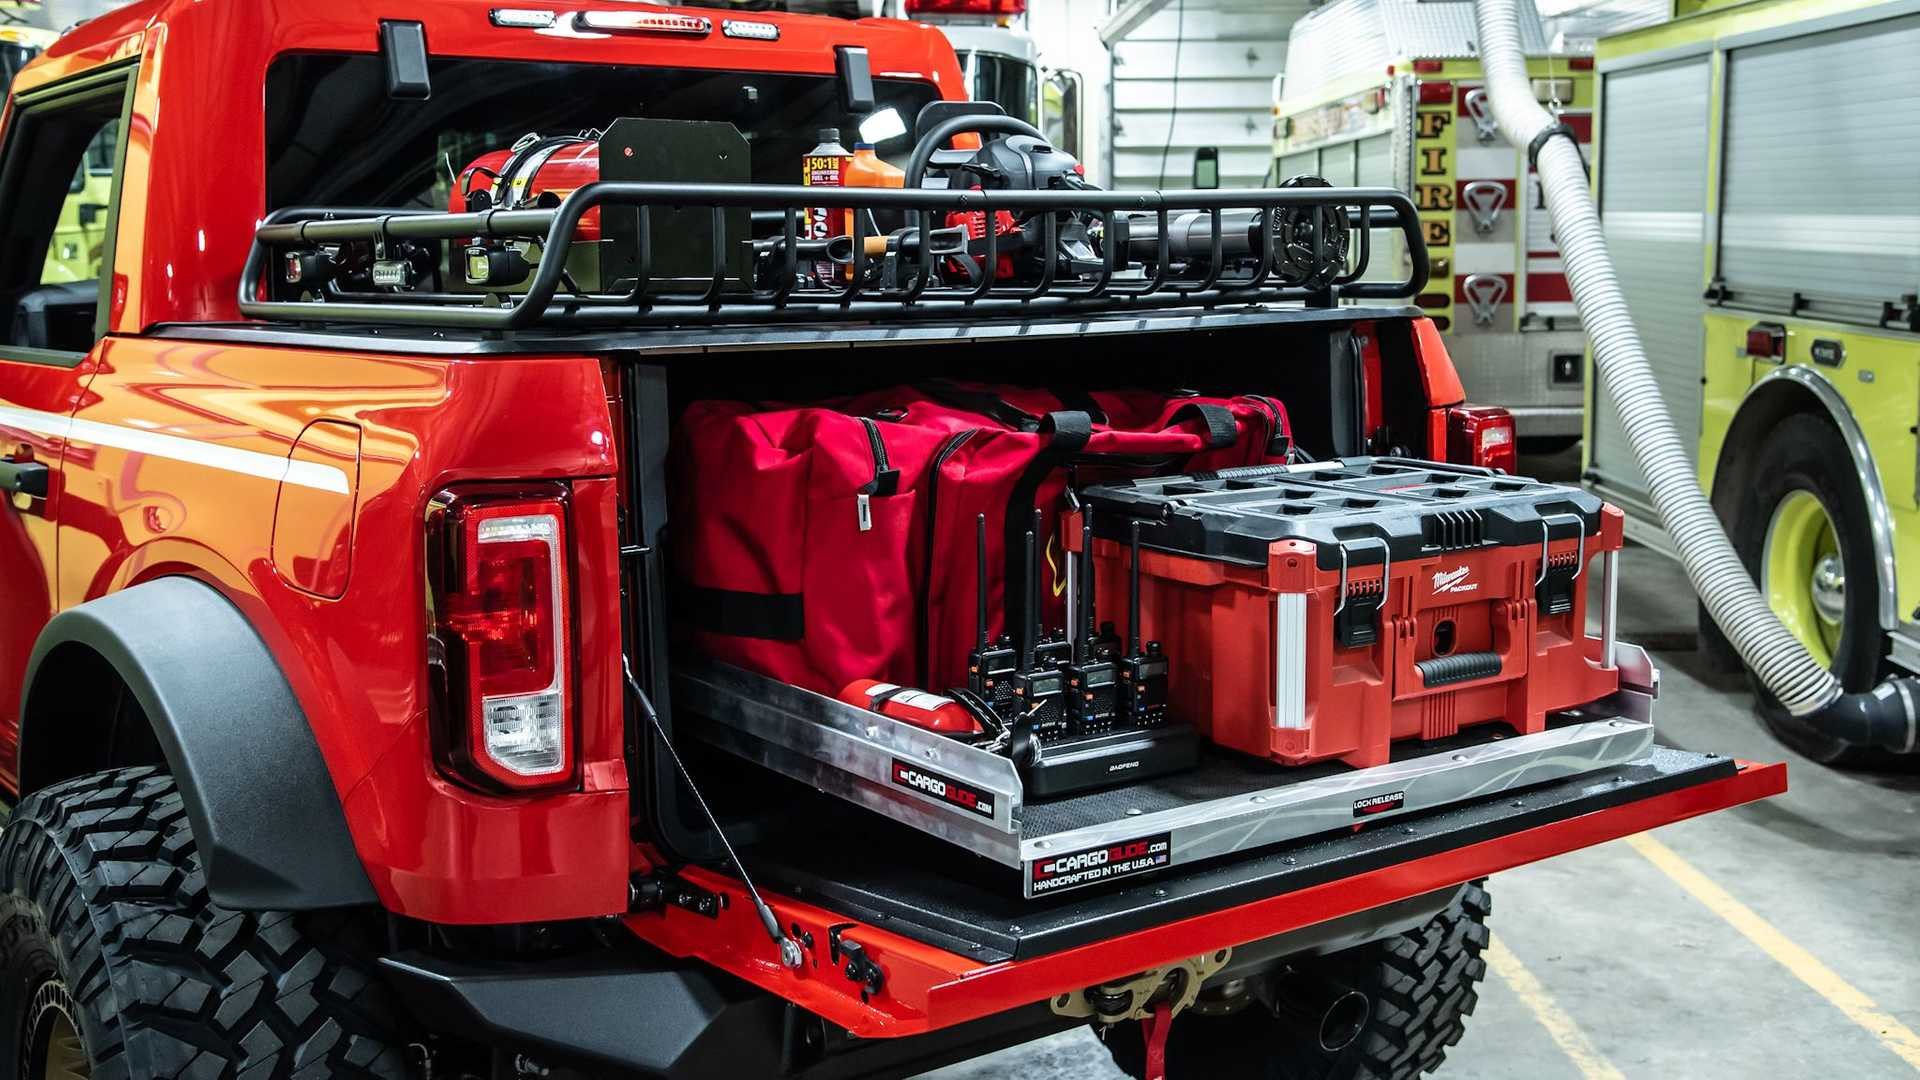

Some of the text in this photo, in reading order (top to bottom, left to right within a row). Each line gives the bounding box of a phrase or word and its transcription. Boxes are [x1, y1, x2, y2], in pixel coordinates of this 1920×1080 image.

[811, 157, 831, 170] 50:1
[1416, 112, 1453, 247] FIRE
[1432, 565, 1470, 589] Milwaukee
[1353, 792, 1404, 809] LOCK RELEASE
[1033, 857, 1156, 892] HANDCRAFTED IN THE U.S.A.
